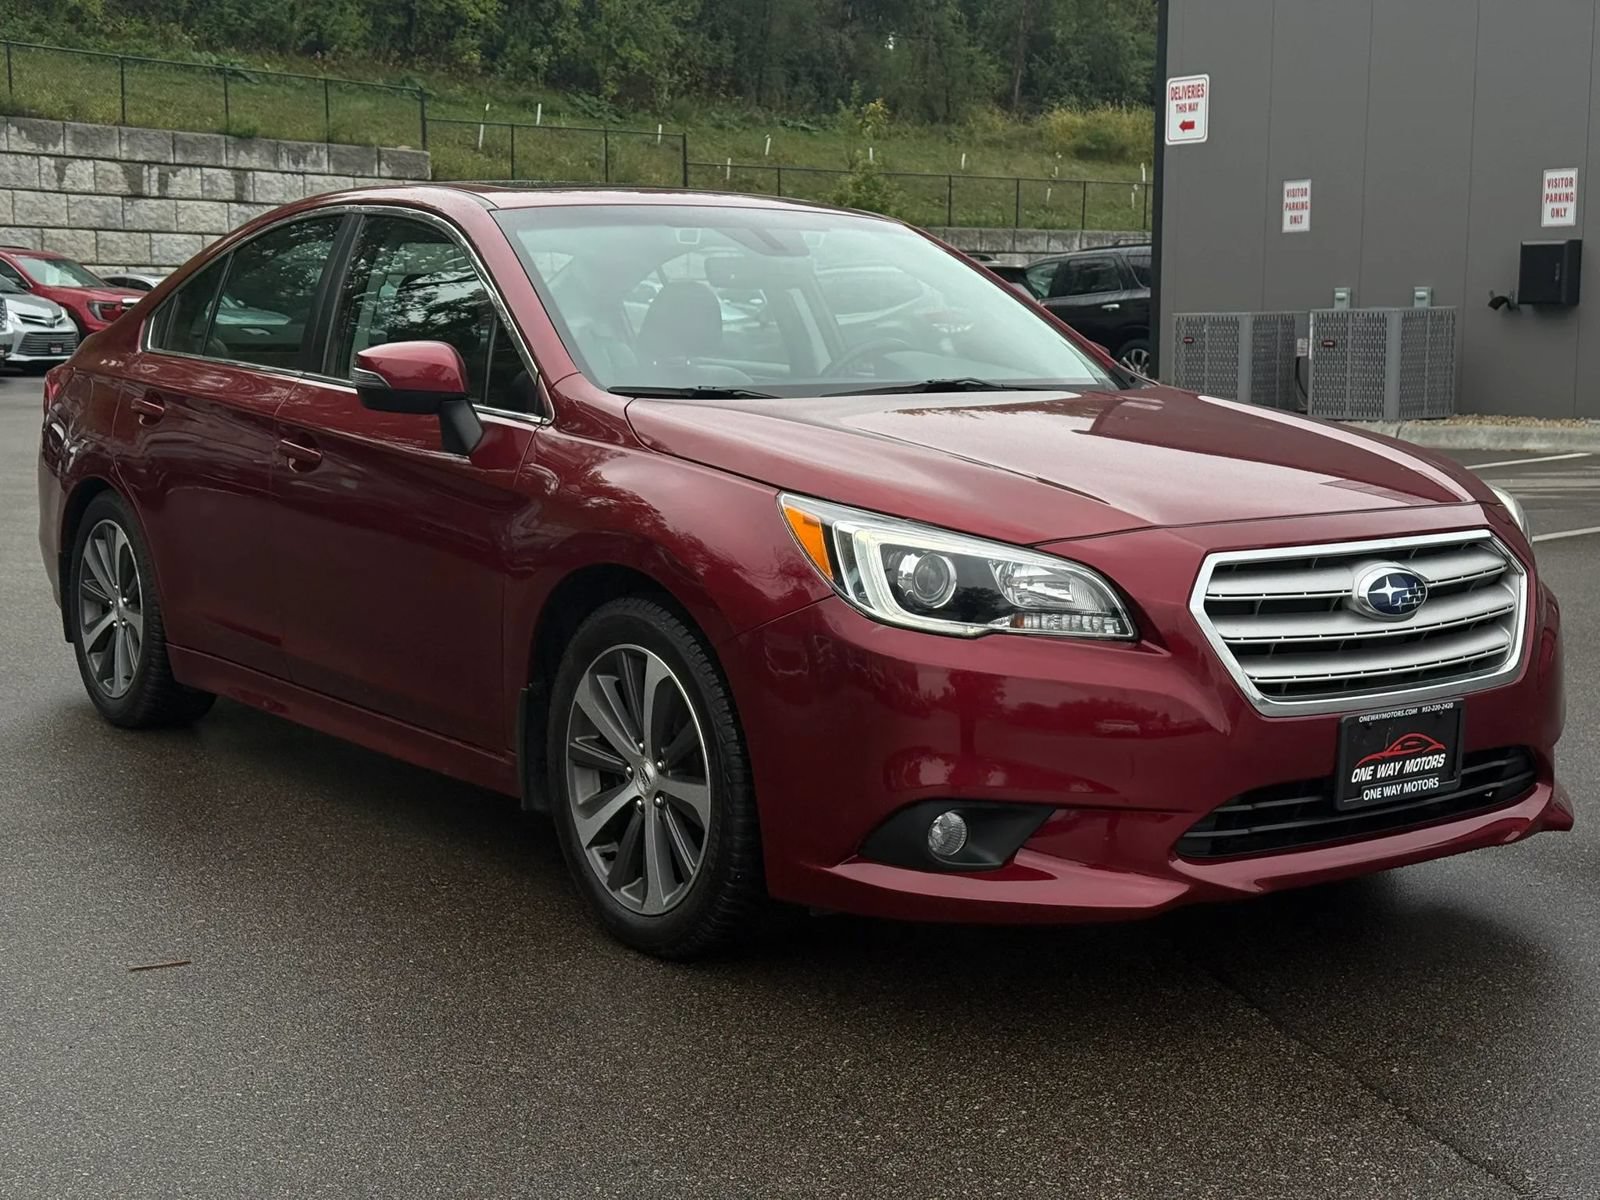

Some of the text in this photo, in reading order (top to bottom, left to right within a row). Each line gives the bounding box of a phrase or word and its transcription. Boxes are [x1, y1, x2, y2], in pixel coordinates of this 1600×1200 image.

[1171, 83, 1204, 101] DELIVERIES
[1176, 102, 1199, 113] THIS WAY
[1547, 177, 1574, 189] VISITOR
[1545, 191, 1574, 204] PARKING
[1551, 207, 1567, 218] ONLY
[1358, 708, 1418, 723] ONEWAYMOTORS.COM
[1351, 753, 1446, 783] ONE WAY MOTORS
[1363, 777, 1439, 801] ONE WAY MOTORS
